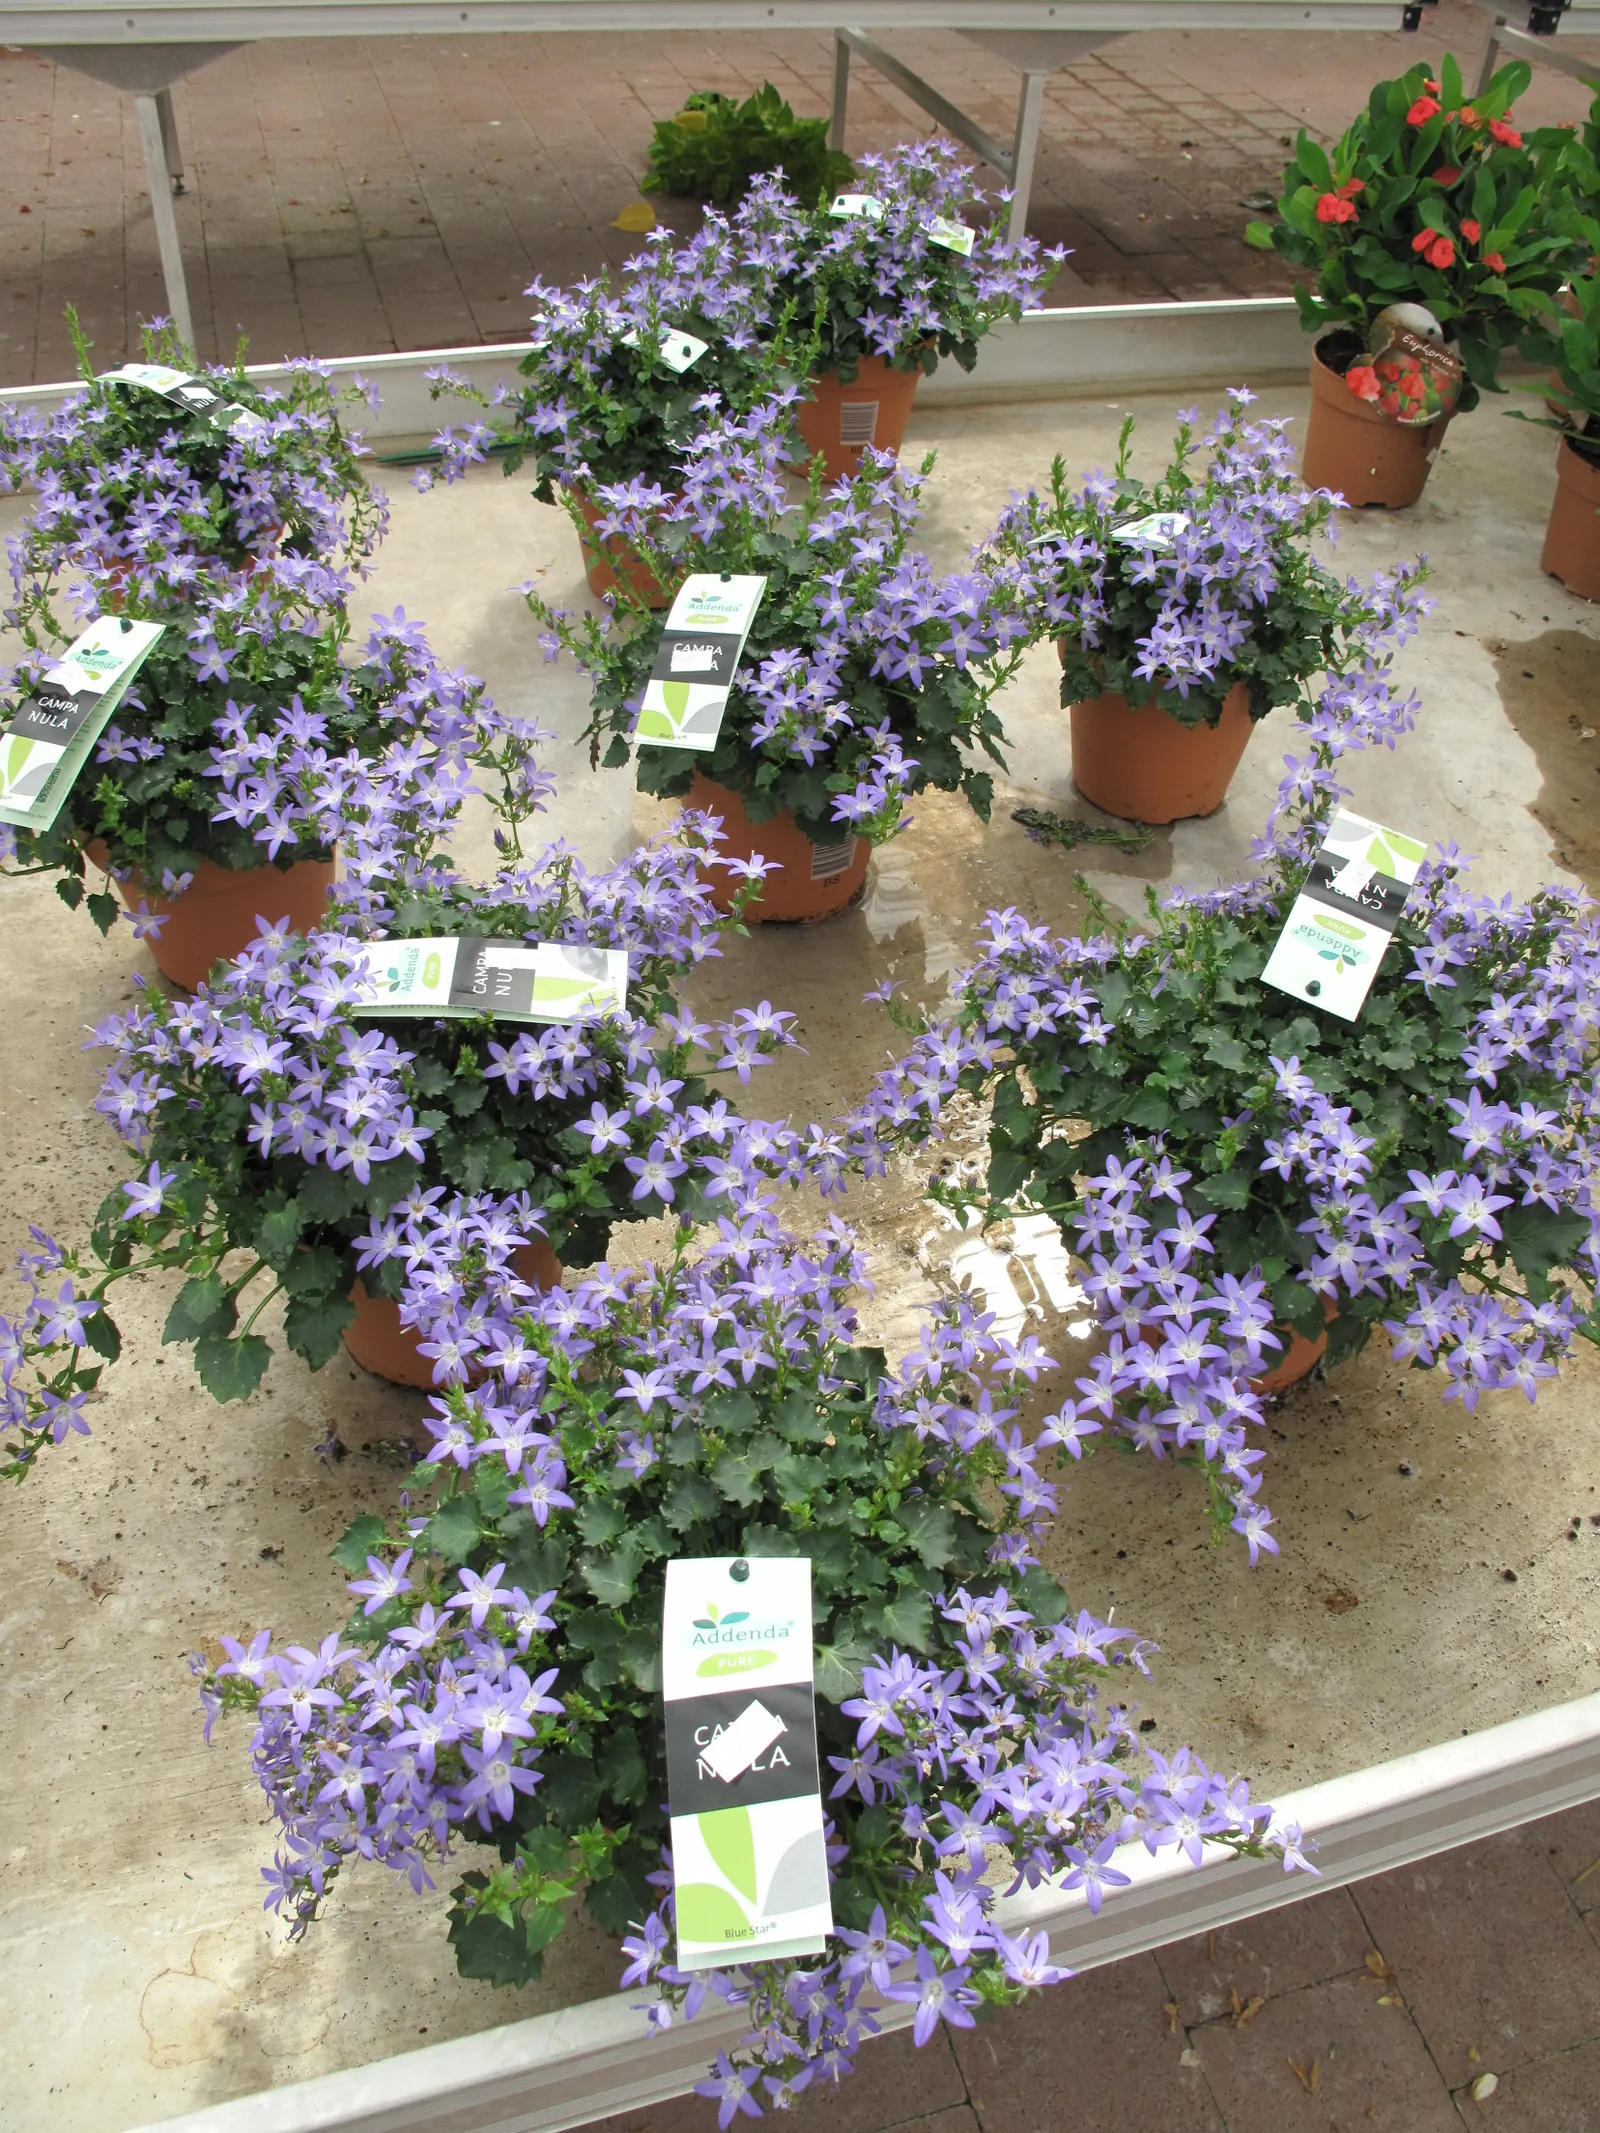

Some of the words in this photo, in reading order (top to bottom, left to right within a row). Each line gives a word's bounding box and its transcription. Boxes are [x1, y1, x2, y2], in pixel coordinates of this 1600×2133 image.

[688, 603, 739, 611] Addenda
[75, 655, 116, 670] Addenda
[38, 696, 79, 714] CAMPA
[28, 711, 69, 730] NULA
[1331, 865, 1387, 898] NA
[1299, 924, 1362, 957] Addenda
[401, 948, 420, 991] Addenda
[717, 1655, 755, 1670] PURE
[696, 1745, 791, 1780] NLA
[724, 1928, 747, 1938] Blue
